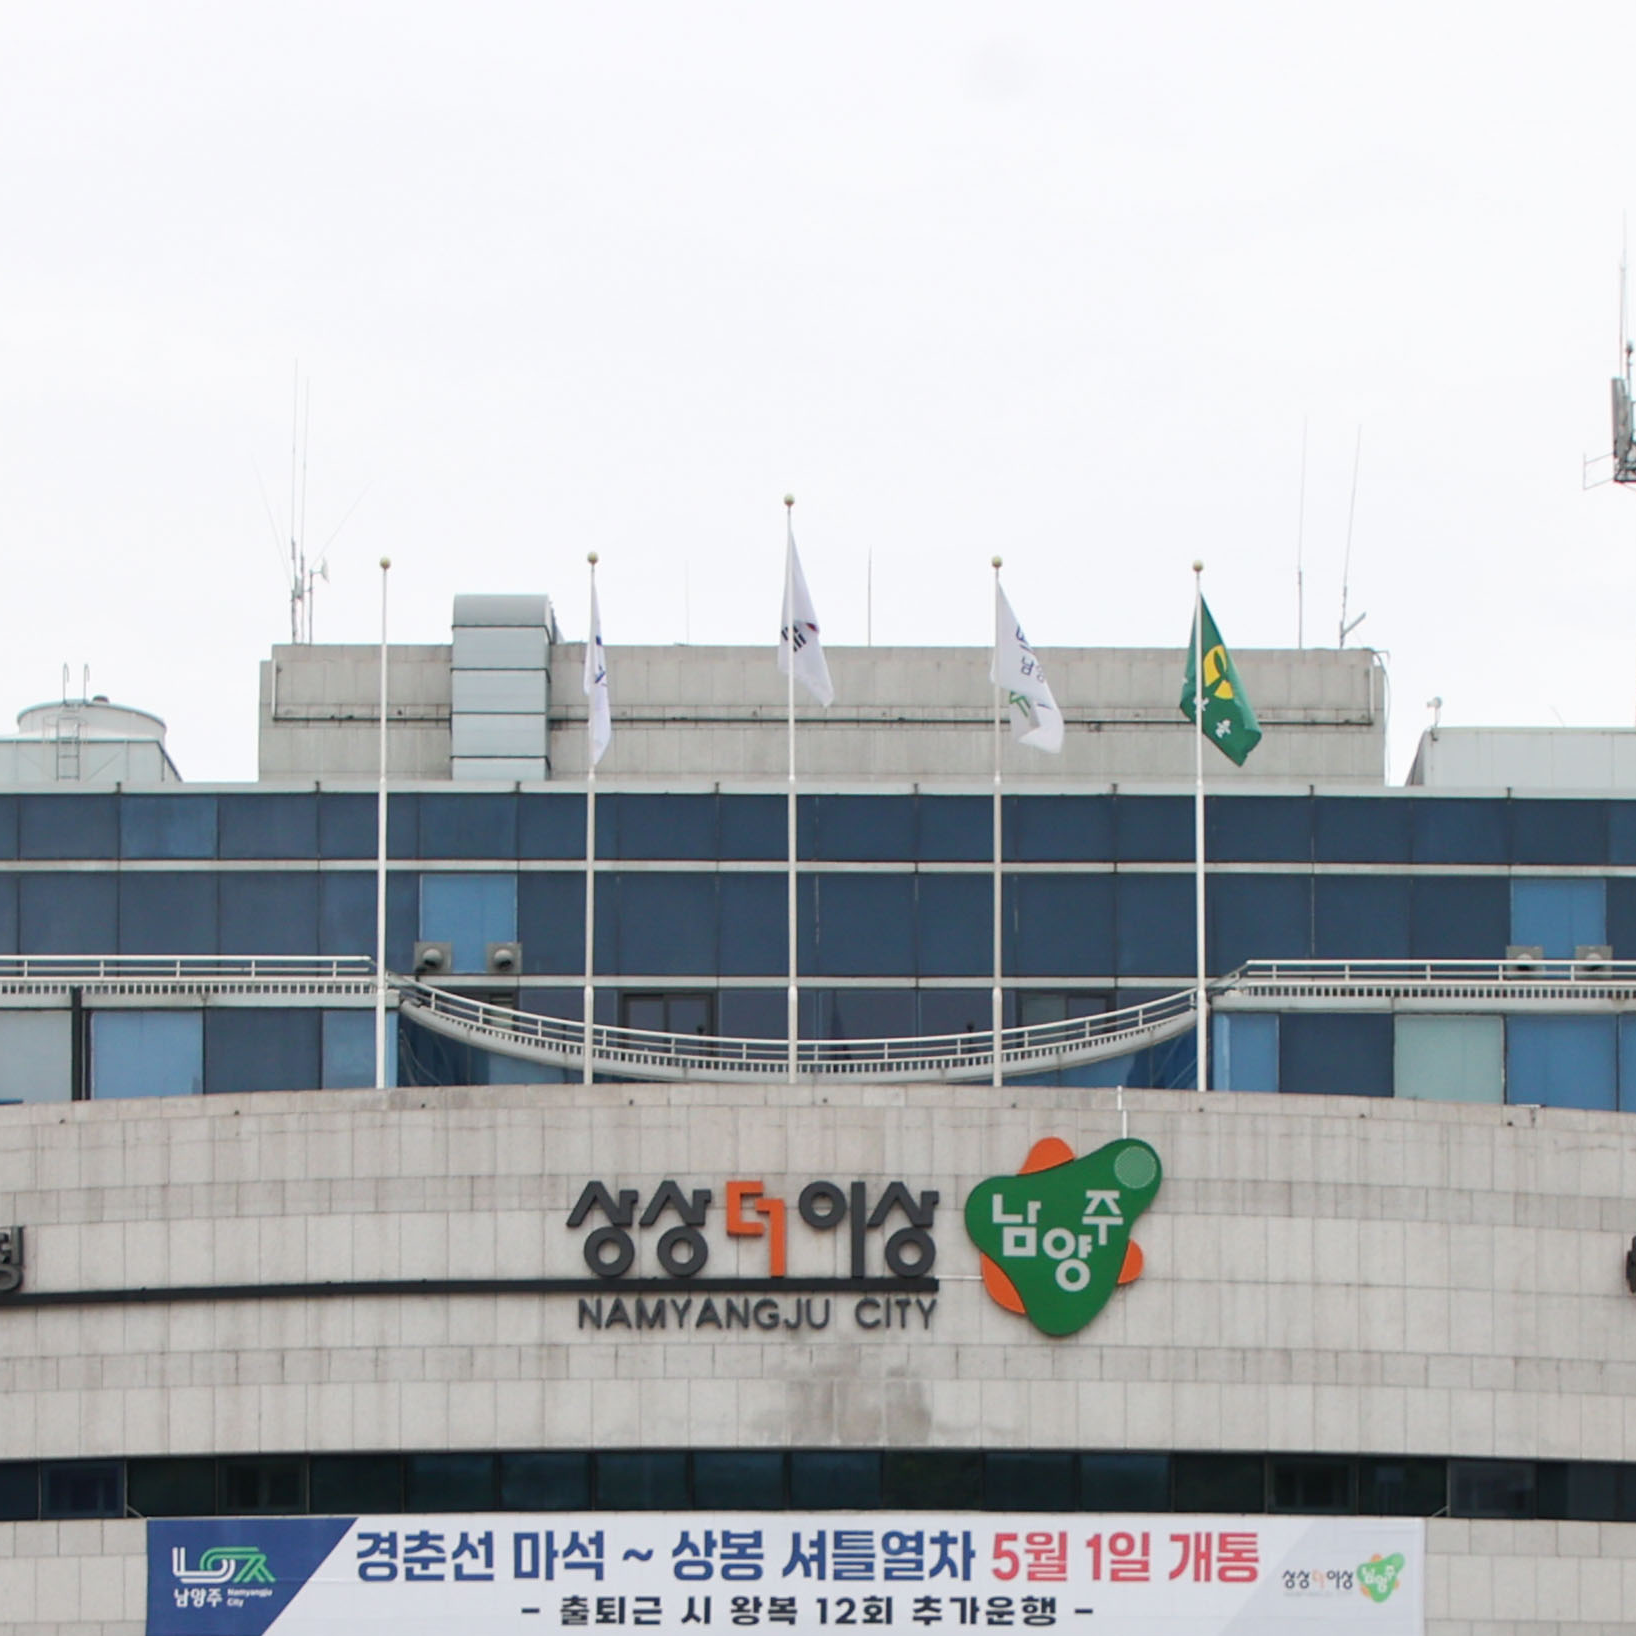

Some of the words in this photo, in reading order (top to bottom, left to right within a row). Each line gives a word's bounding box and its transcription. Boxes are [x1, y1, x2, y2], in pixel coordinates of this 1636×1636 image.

[991, 1190, 1123, 1291] 남양주
[576, 1297, 831, 1330] NAMYANGJU
[853, 1297, 939, 1331] CITY
[356, 1530, 495, 1582] 경춘선
[512, 1530, 605, 1582] 마석
[672, 1530, 764, 1582] 상봉
[781, 1530, 976, 1582] 셔틀열차
[991, 1531, 1069, 1583] 5월
[1085, 1531, 1151, 1583] 1일
[1168, 1531, 1260, 1583] 개통
[174, 1587, 223, 1608] 남양주
[227, 1598, 245, 1608] City
[559, 1596, 663, 1626] 출퇴근
[680, 1596, 711, 1626] 시
[729, 1596, 798, 1626] 왕복
[816, 1597, 893, 1626] 12회
[912, 1596, 1058, 1627] 추가운행
